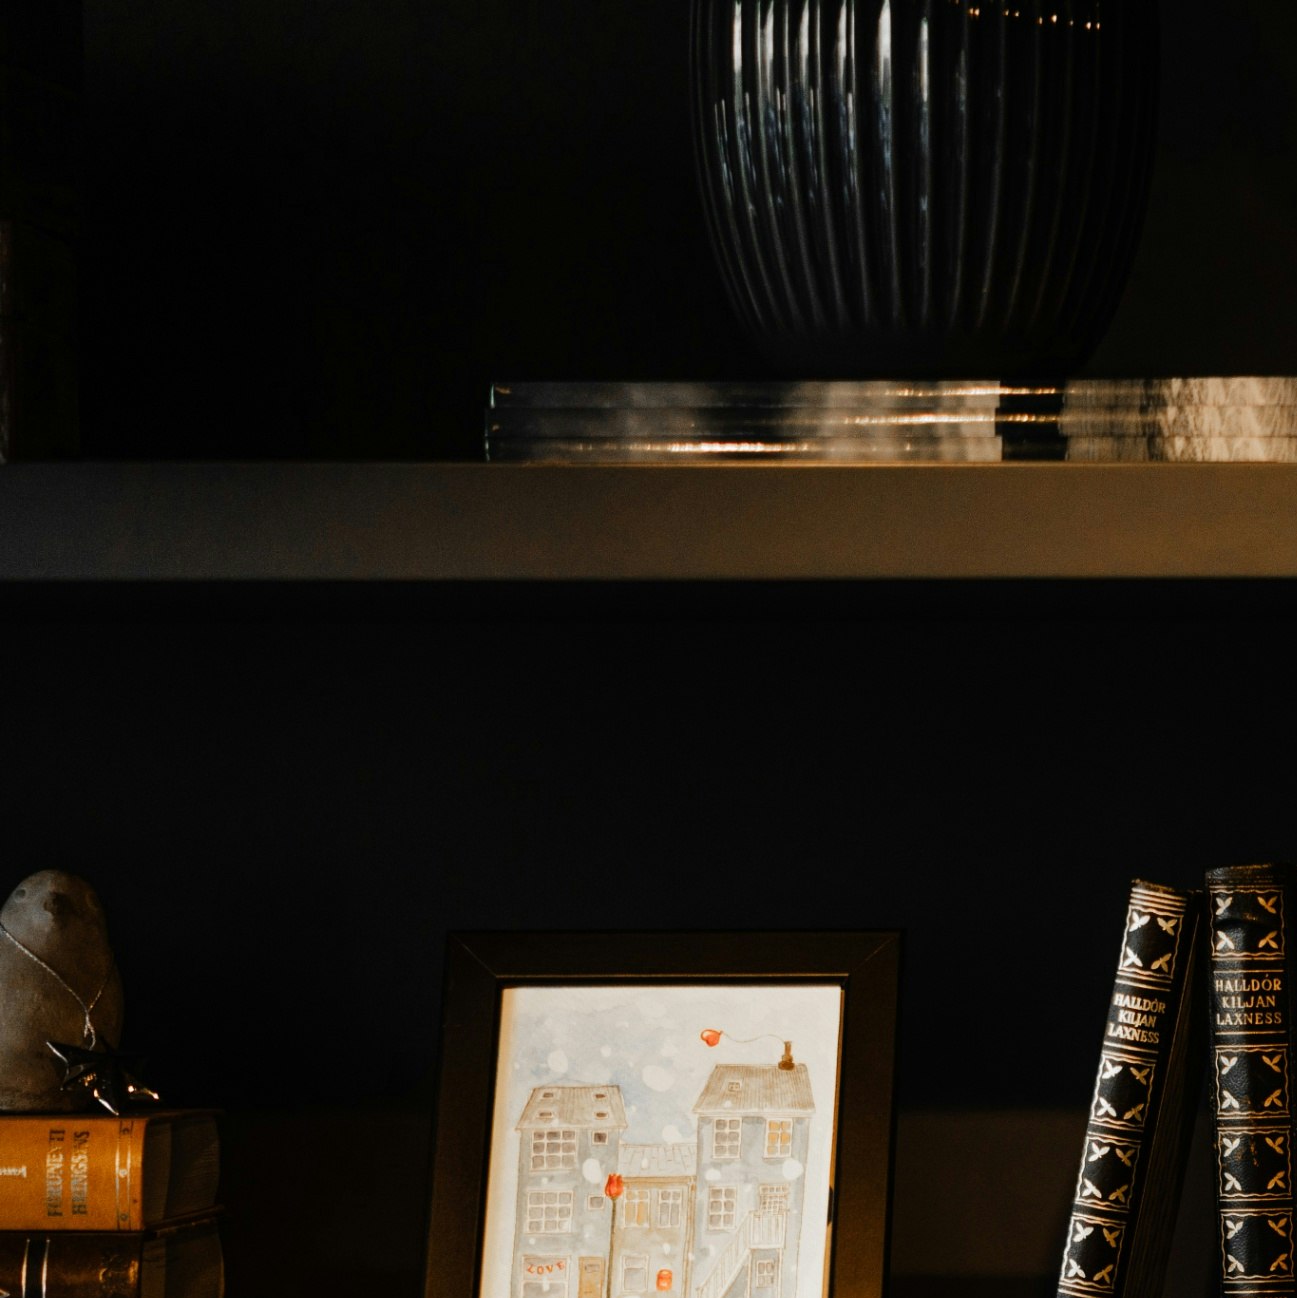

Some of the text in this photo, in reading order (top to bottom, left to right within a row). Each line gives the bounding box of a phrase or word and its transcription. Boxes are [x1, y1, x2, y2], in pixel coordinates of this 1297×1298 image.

[1215, 973, 1283, 993] HALLDÓR
[1113, 992, 1167, 1015] HALLDÓR
[1221, 995, 1277, 1009] KILJAN
[1118, 1010, 1157, 1028] KILJAN
[1216, 1011, 1283, 1026] LAXNESS
[1108, 1022, 1160, 1044] LAXNESS
